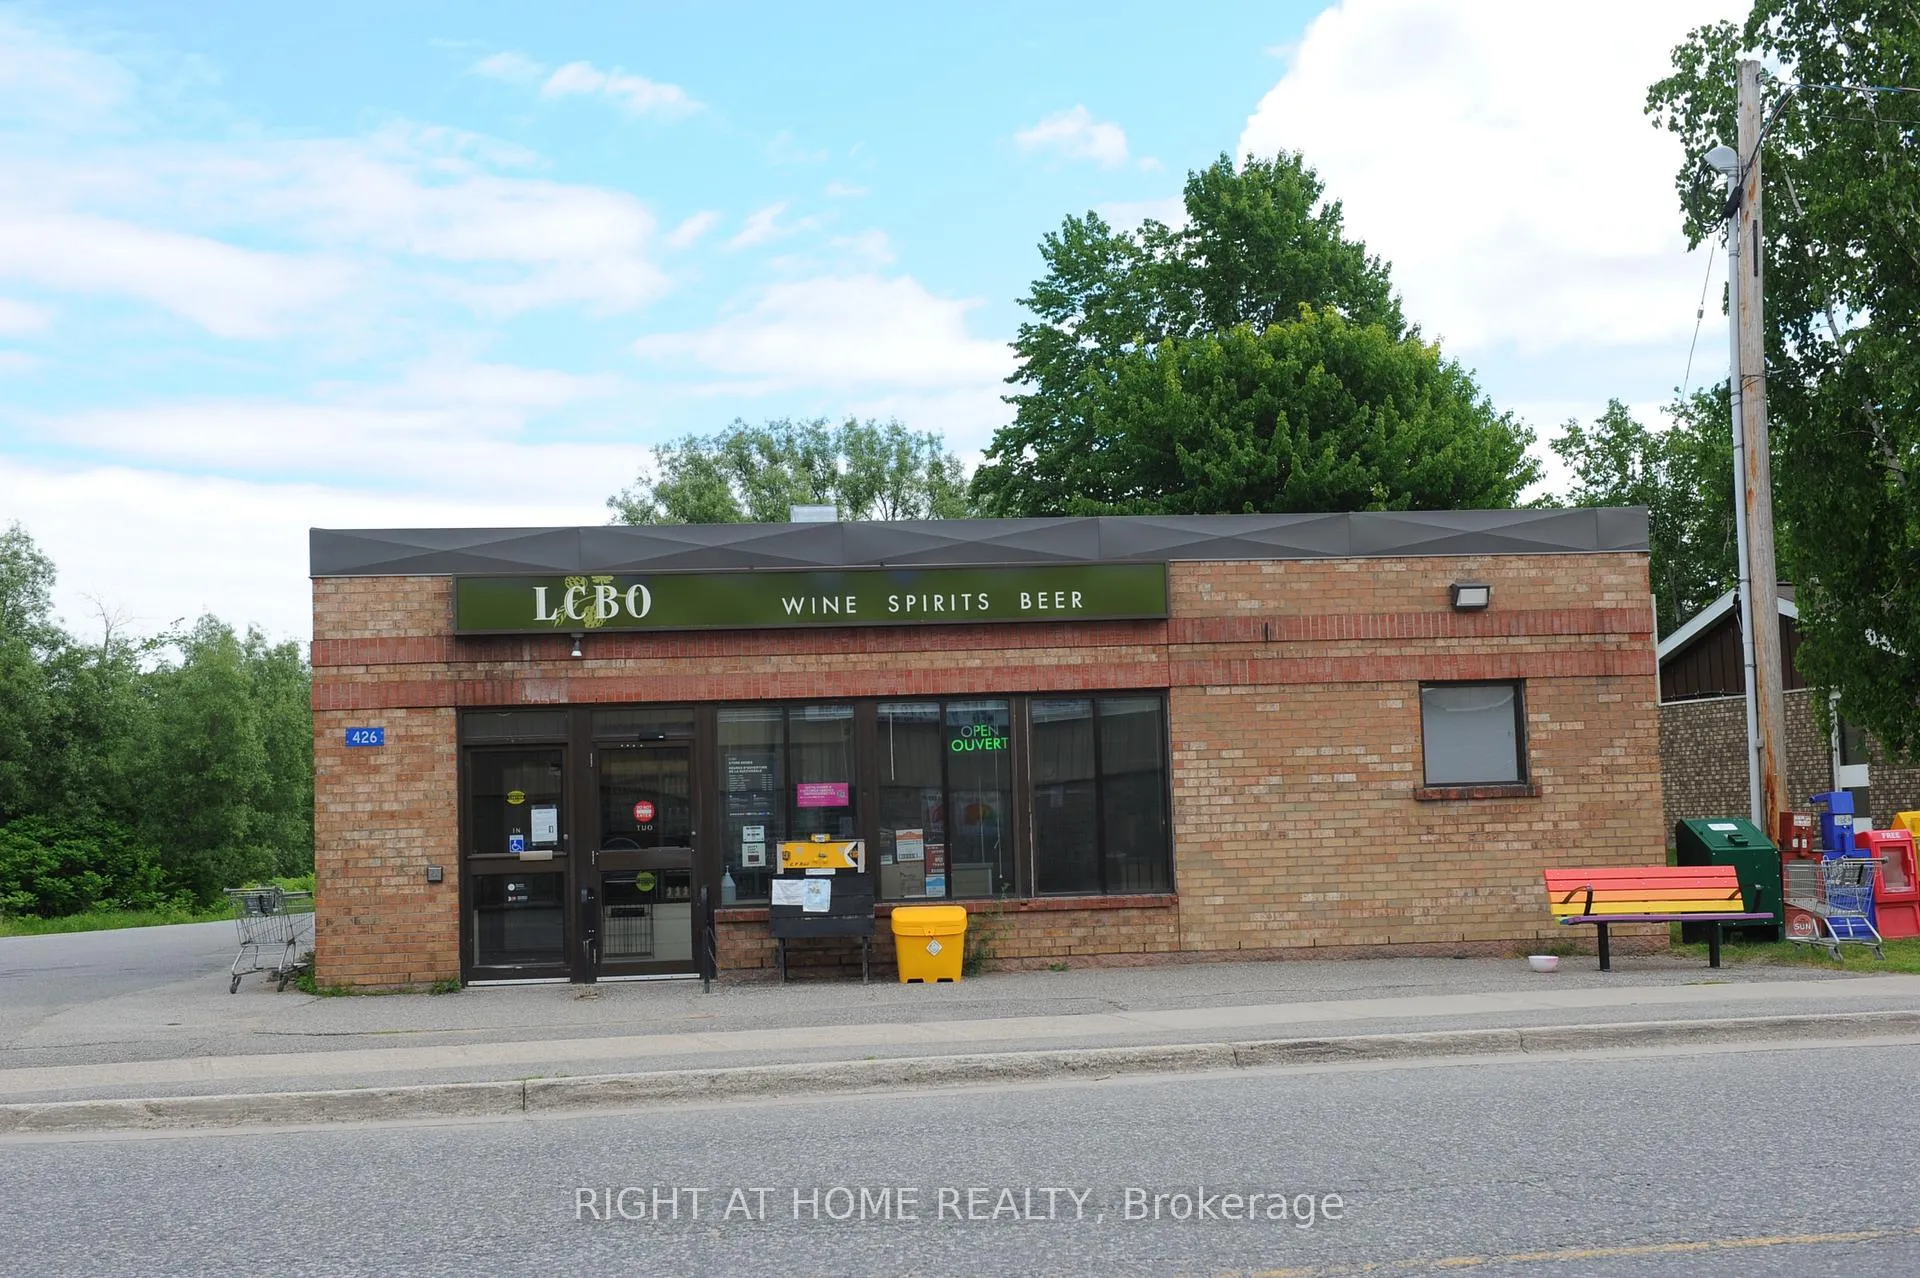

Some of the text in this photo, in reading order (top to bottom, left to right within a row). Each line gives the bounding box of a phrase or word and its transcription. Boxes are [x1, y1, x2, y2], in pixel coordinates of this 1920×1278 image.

[532, 584, 652, 620] LCBO
[782, 591, 1083, 615] WINE SPIRITS BEER
[352, 731, 378, 743] 426
[961, 724, 999, 737] OPEN
[951, 737, 1009, 752] OUVERT
